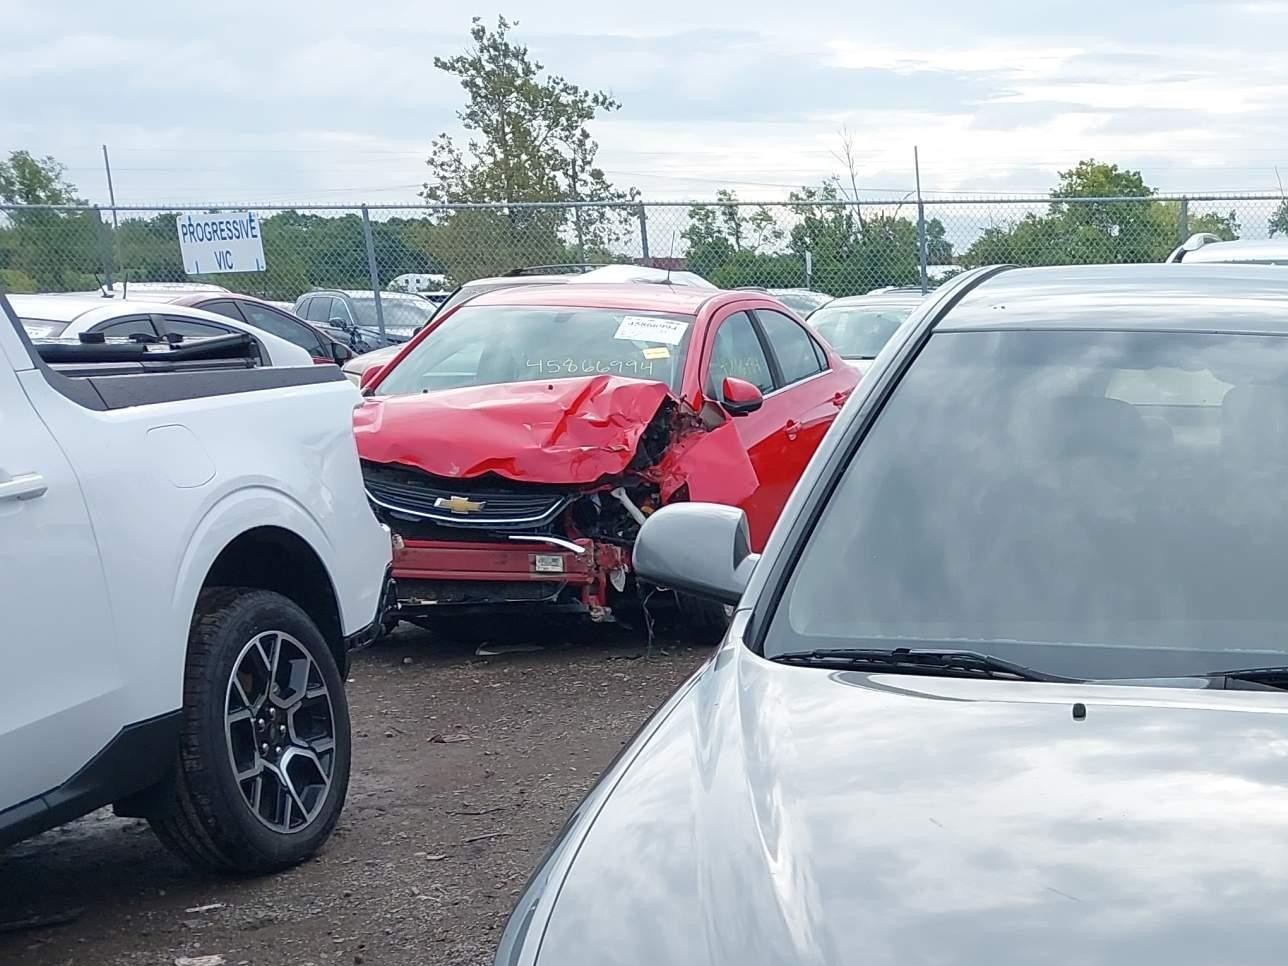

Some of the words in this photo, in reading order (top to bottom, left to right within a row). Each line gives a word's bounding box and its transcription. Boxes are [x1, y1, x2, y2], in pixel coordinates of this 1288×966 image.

[181, 218, 258, 244] PROGRESSIVE
[214, 250, 234, 270] VIC
[526, 358, 654, 376] 45866994
